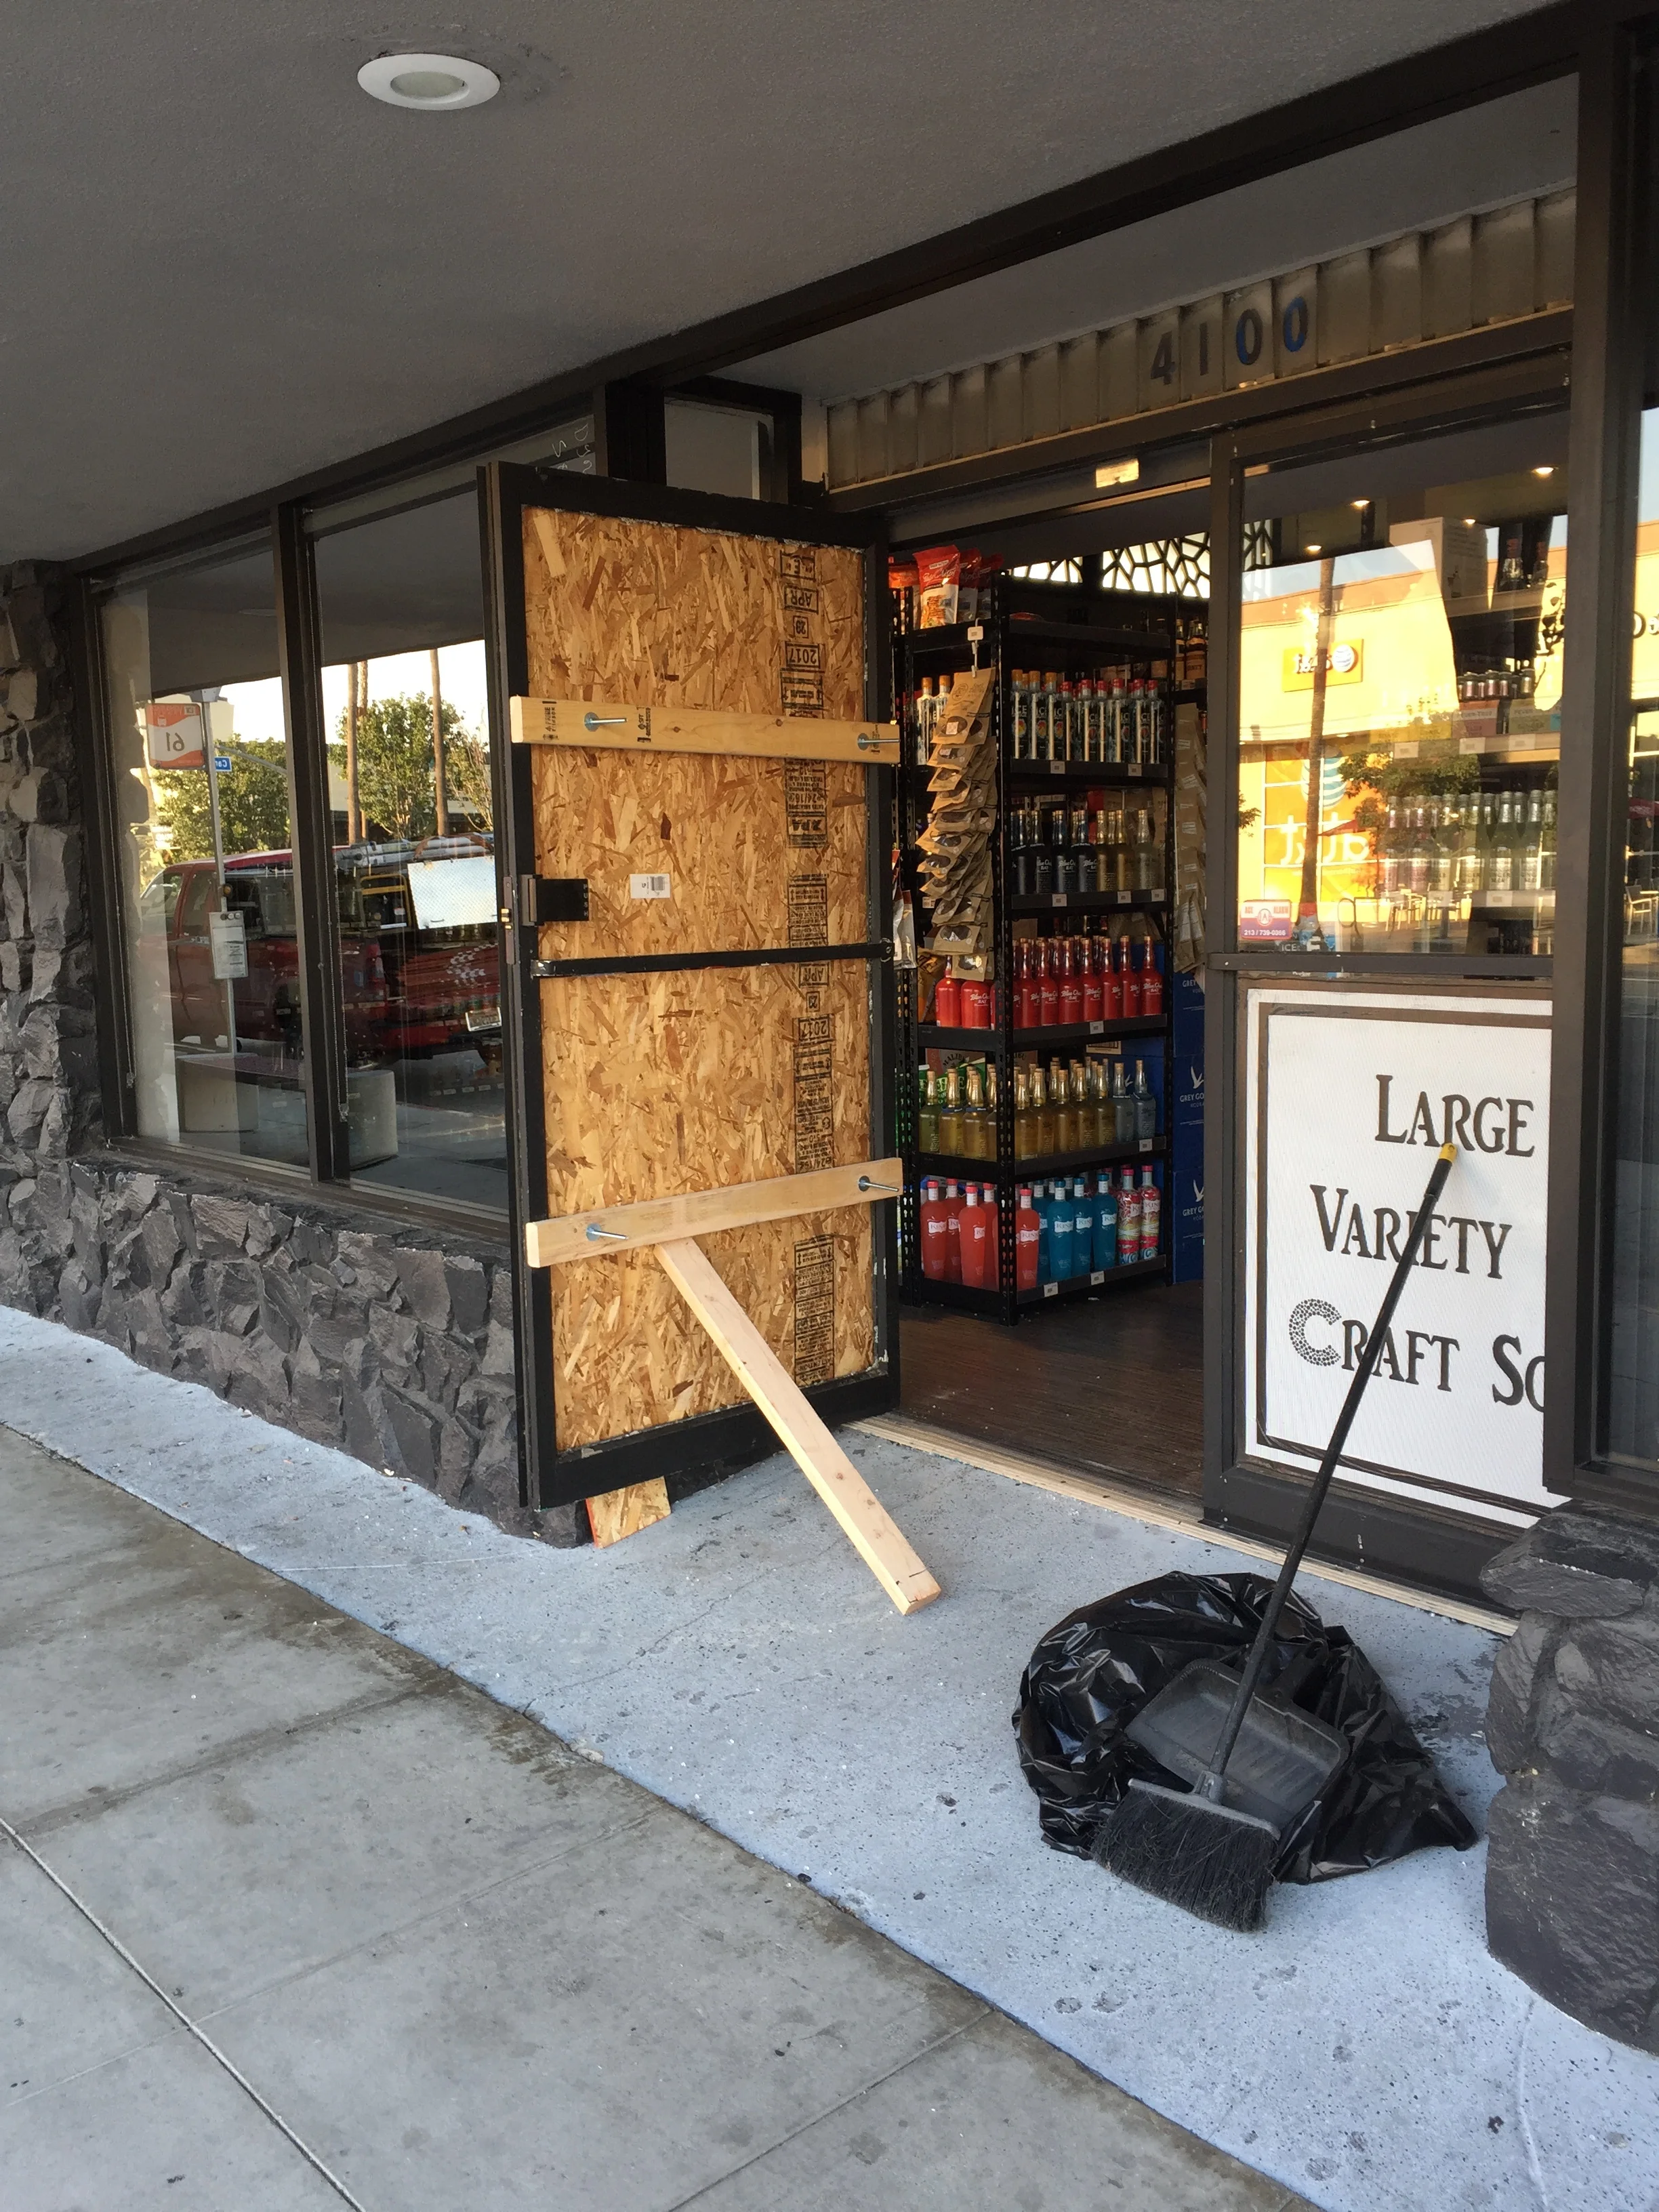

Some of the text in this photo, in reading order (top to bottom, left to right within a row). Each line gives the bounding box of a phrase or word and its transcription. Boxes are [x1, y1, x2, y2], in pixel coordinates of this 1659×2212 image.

[1150, 295, 1309, 386] 4100
[790, 590, 813, 607] APR
[789, 648, 817, 664] 2017
[798, 1021, 830, 1038] 2017
[1179, 1093, 1195, 1103] GREY
[1374, 1073, 1535, 1158] LARGE
[1288, 1298, 1460, 1393] CRAFT
